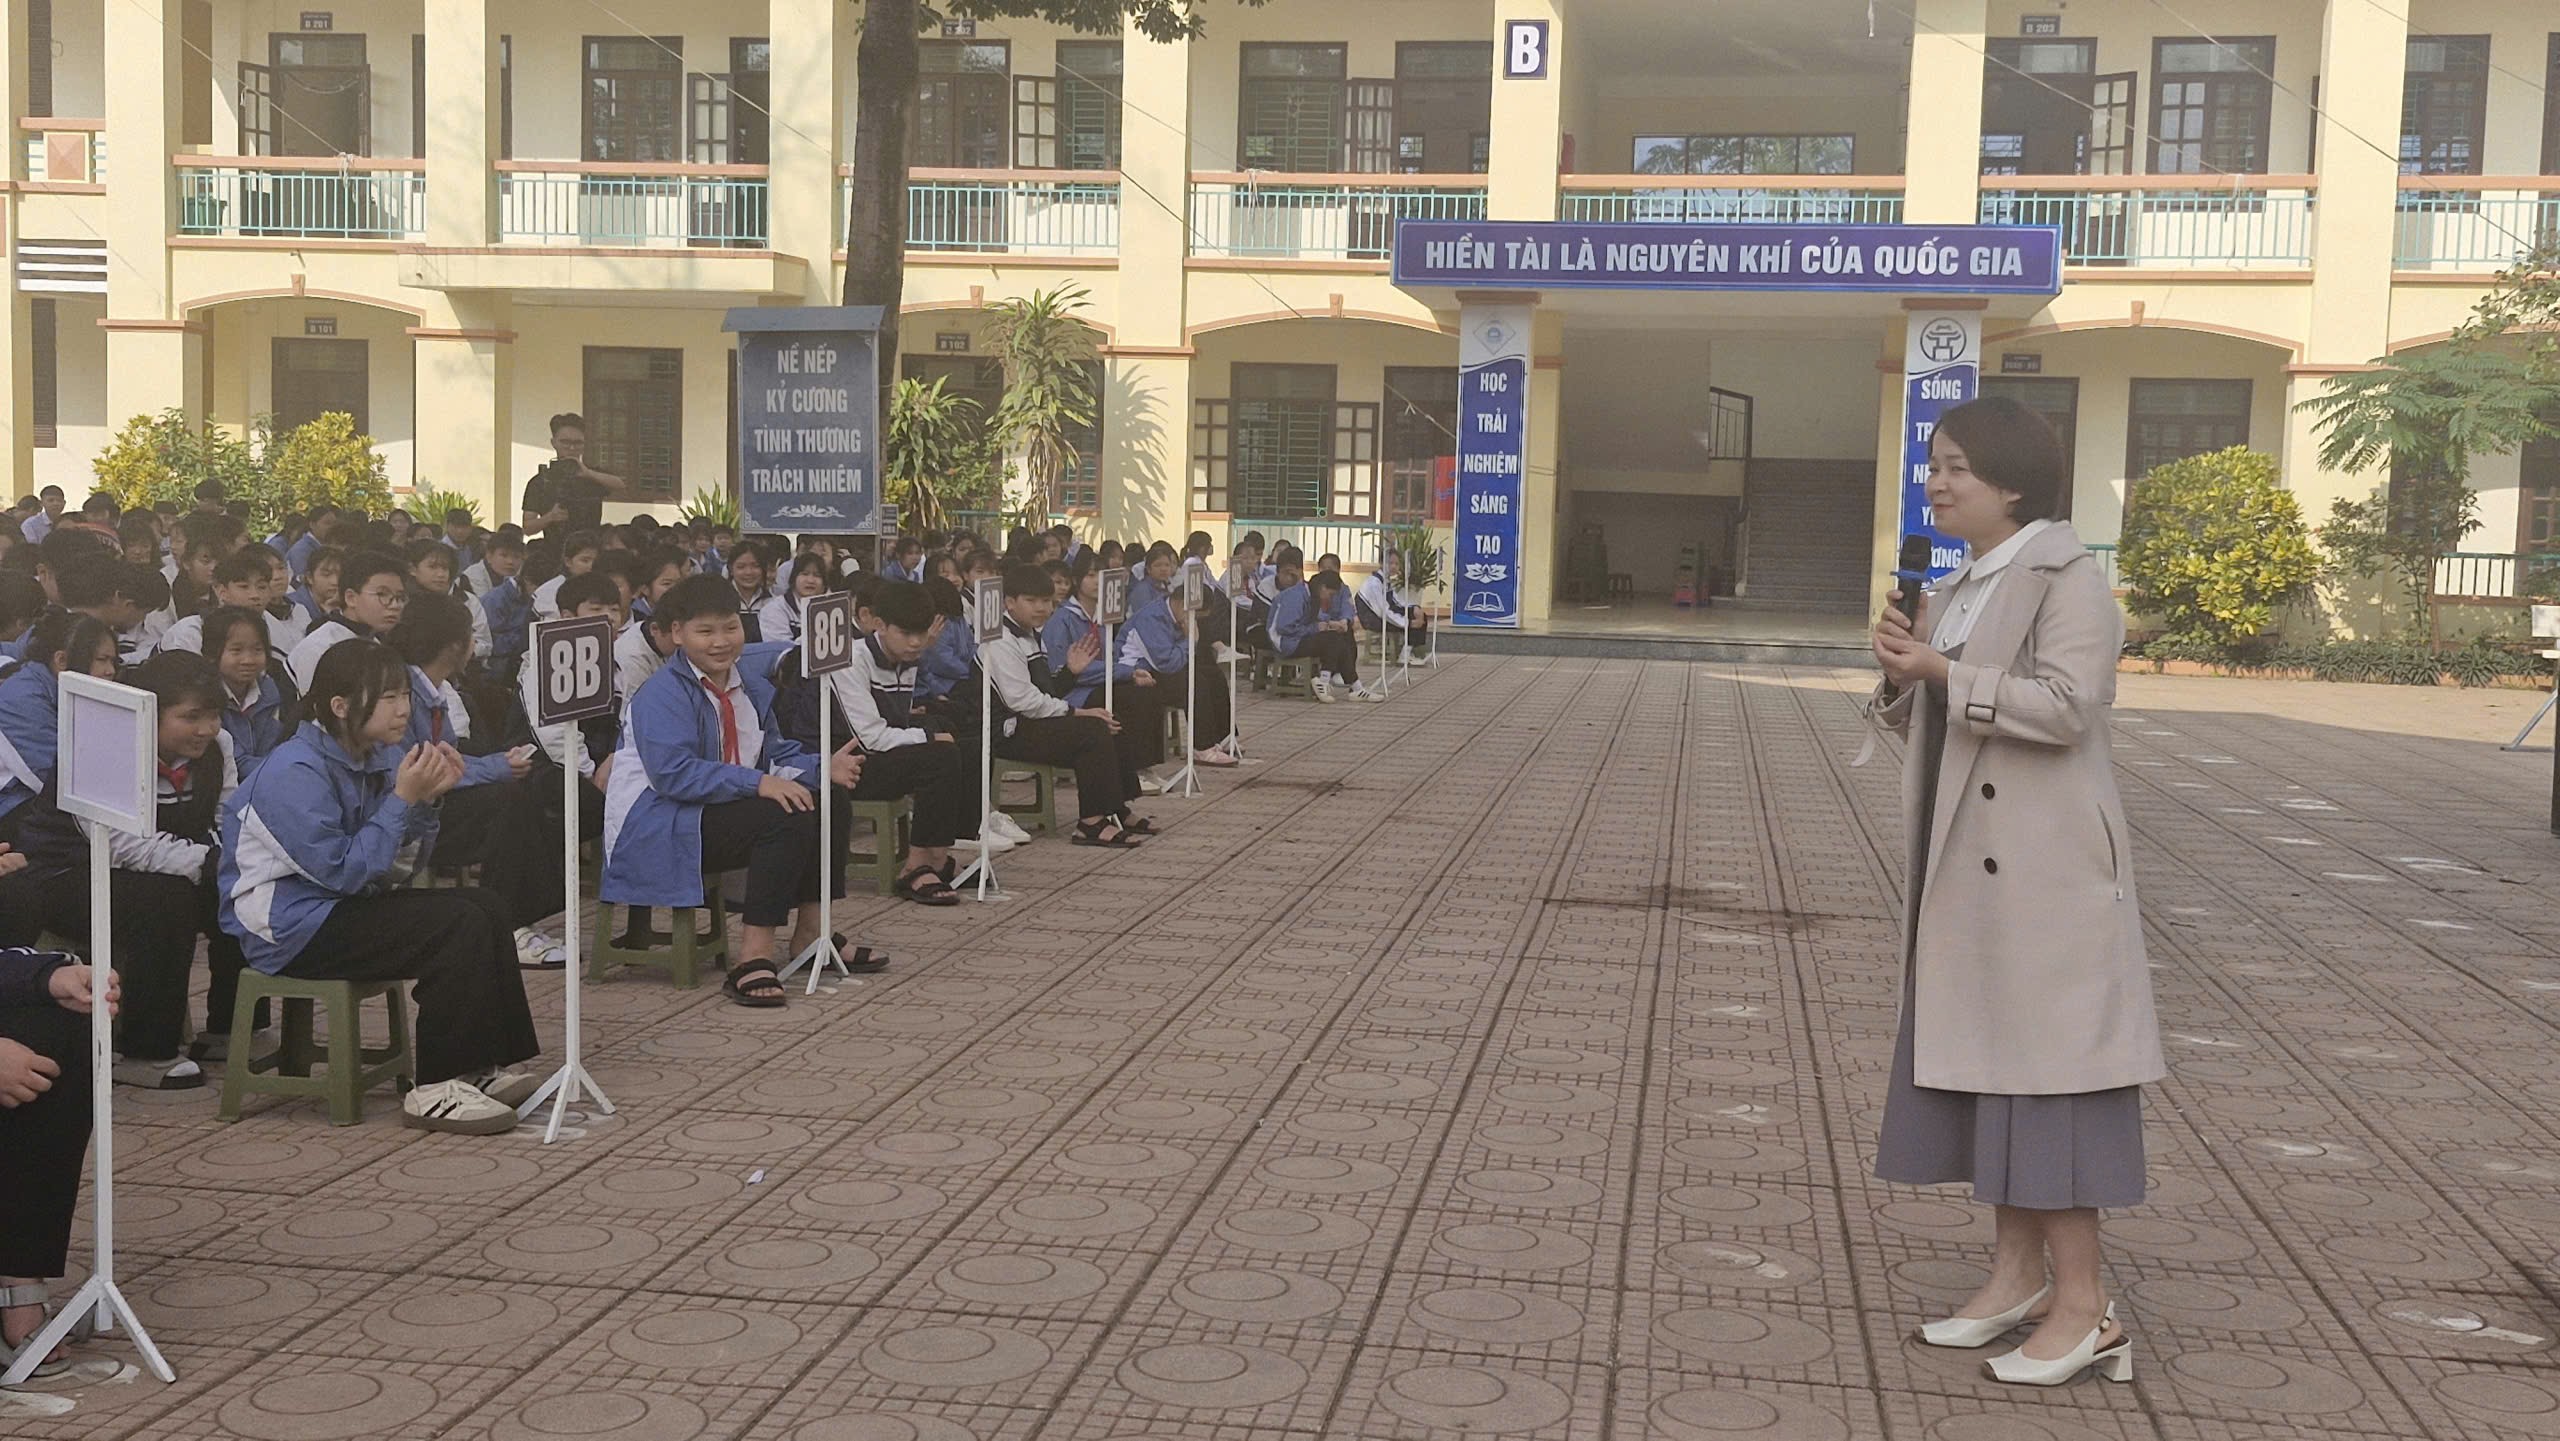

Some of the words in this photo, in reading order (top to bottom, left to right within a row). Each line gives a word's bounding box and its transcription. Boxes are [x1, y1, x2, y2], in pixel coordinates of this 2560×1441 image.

[313, 20, 328, 28] 201
[2026, 24, 2033, 33] B
[2036, 24, 2055, 33] 203
[1511, 25, 1540, 73] B
[1425, 233, 1496, 270] HIỀN
[1505, 237, 1550, 271] TÀI
[1560, 237, 1597, 272] LÀ
[1606, 238, 1730, 273] NGUYÊN
[1739, 239, 1792, 274] KHÍ
[1801, 236, 1864, 275] CỦA
[1874, 236, 1959, 278] QUỐC
[1969, 247, 2023, 276] GIA
[318, 325, 333, 334] 101
[777, 342, 800, 374] NỀ
[804, 342, 837, 374] NẾP
[949, 341, 965, 350] 102
[766, 379, 787, 413] KỶ
[792, 386, 849, 413] CƯƠNG
[1480, 372, 1508, 396] HỌC
[1921, 372, 1962, 400] SỐNG
[1477, 407, 1508, 433] TRẢI
[754, 424, 792, 453] TÌNH
[796, 427, 861, 454] THƯƠNG
[751, 464, 804, 493] TRÁCH
[1464, 450, 1518, 478] NGHIỆM
[1471, 490, 1508, 515] SÁNG
[1475, 535, 1501, 559] TẠO
[1106, 579, 1121, 614] 8E
[1190, 572, 1201, 601] 9A
[983, 589, 1000, 631] 8D
[814, 607, 845, 661] 8C
[550, 635, 601, 704] 8B
